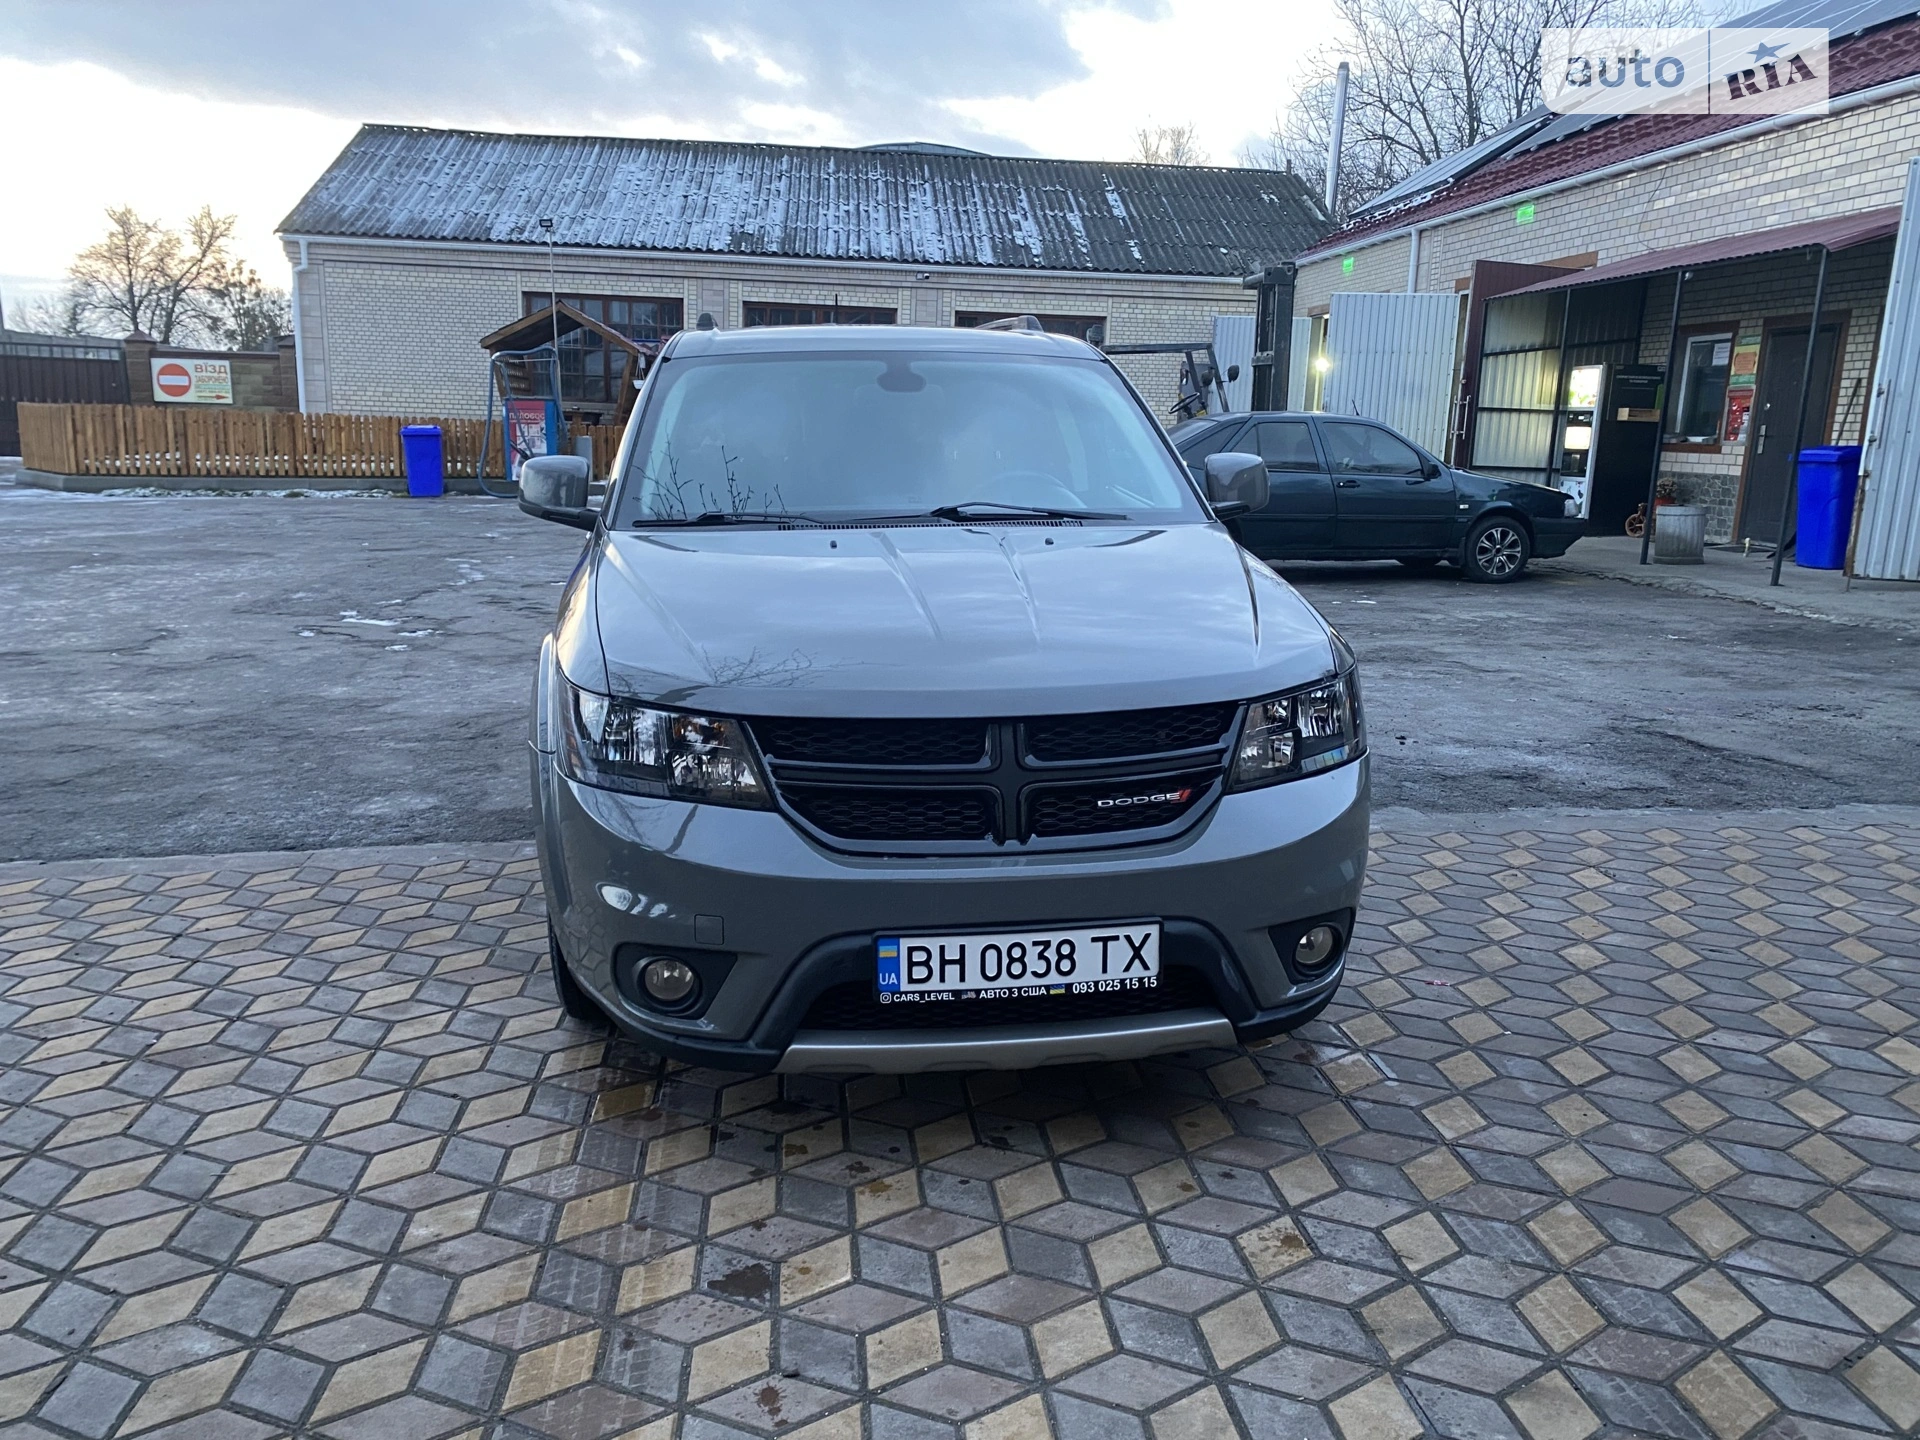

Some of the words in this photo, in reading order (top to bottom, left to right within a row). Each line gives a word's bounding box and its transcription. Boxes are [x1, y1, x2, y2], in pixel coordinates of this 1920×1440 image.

[194, 362, 228, 375] ВЇЗД
[1097, 792, 1181, 807] DODGE
[907, 944, 966, 984] BH
[980, 938, 1077, 982] 0838
[1090, 932, 1152, 975] TX
[880, 973, 898, 985] UA
[979, 989, 1009, 999] АВТО
[1021, 986, 1047, 996] США
[1072, 982, 1095, 994] 093
[1098, 979, 1121, 992] 025
[1124, 978, 1139, 990] 15
[1142, 976, 1157, 988] 15
[894, 992, 955, 1003] CARS_LEVEL
